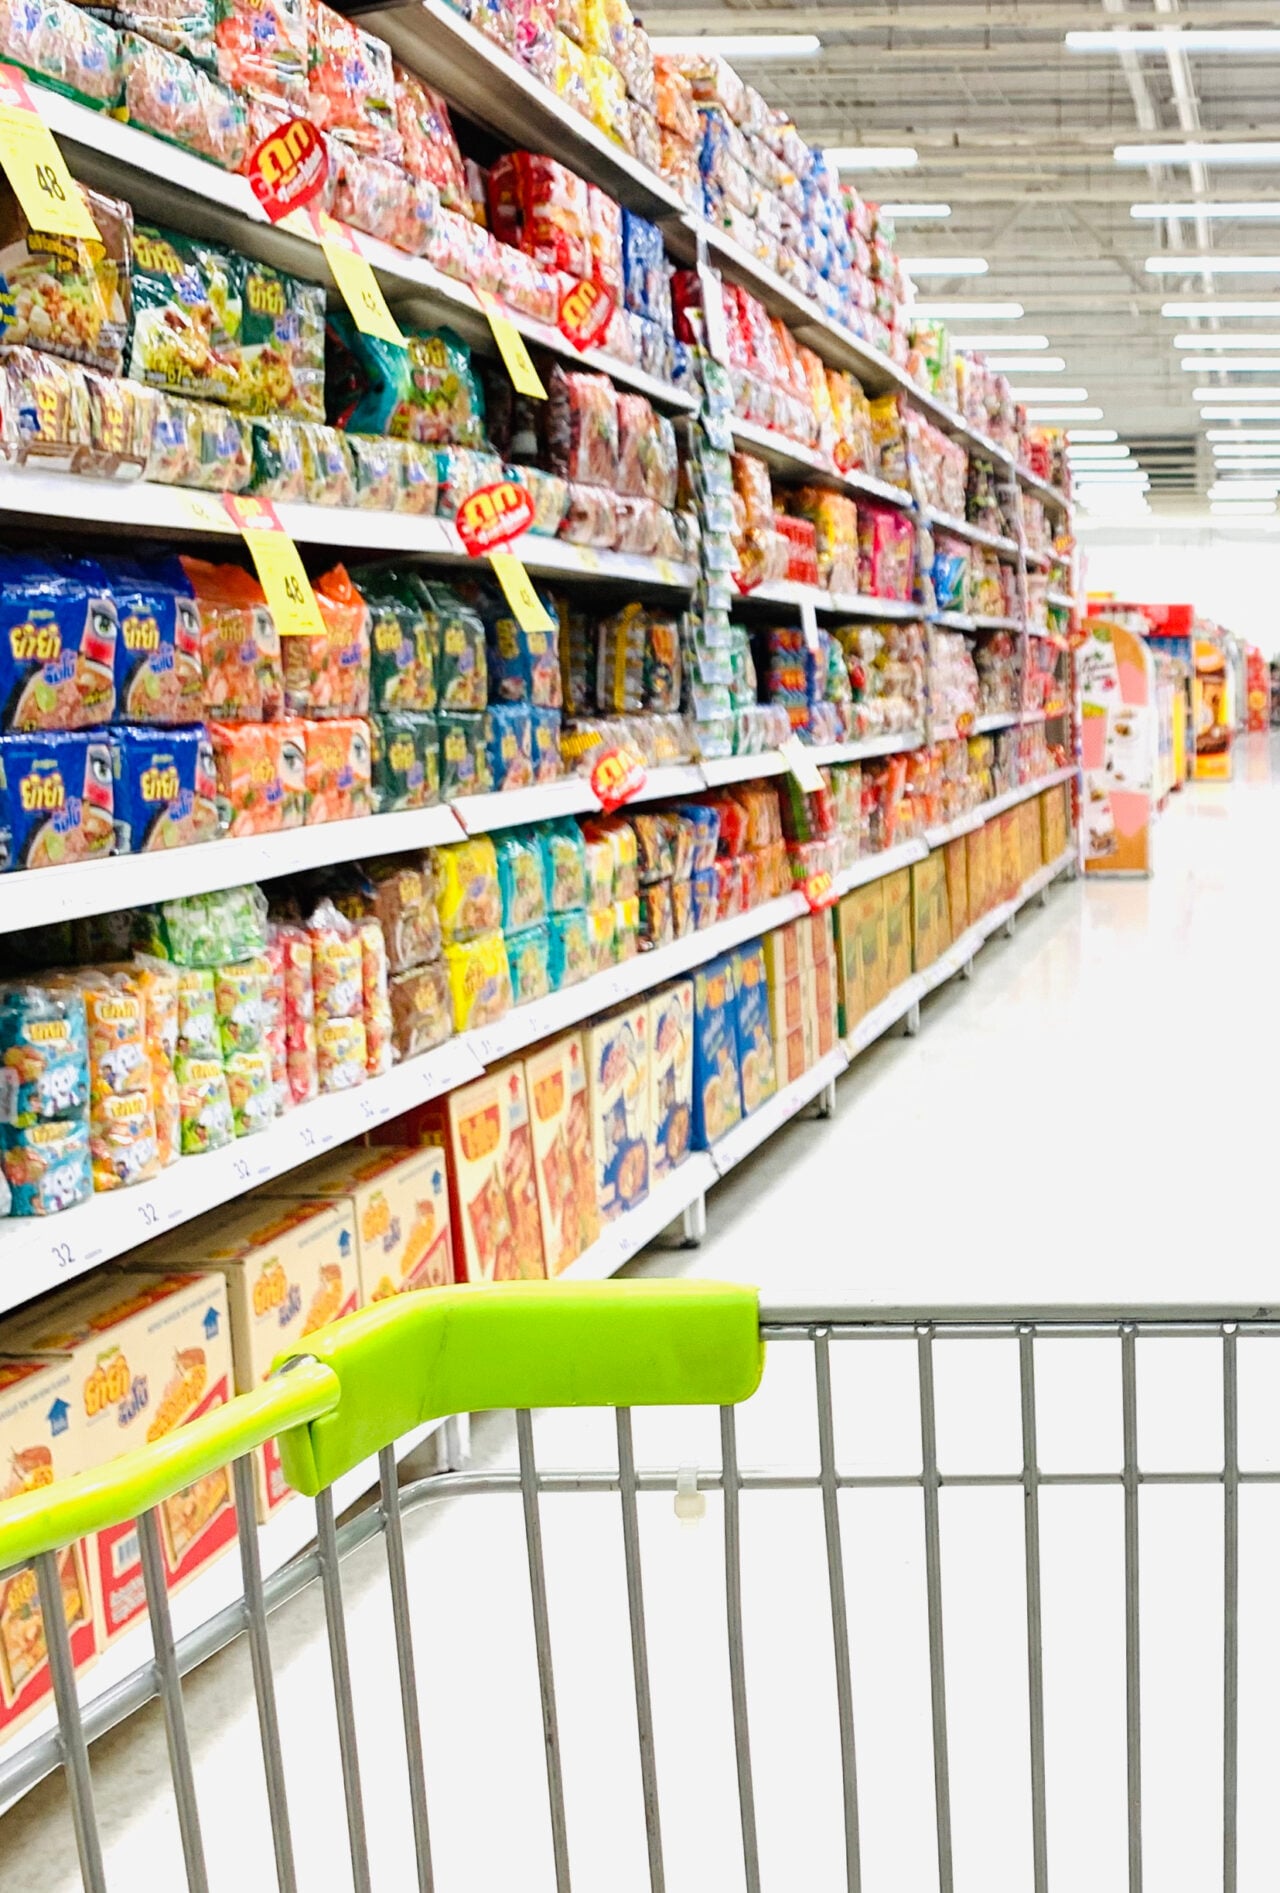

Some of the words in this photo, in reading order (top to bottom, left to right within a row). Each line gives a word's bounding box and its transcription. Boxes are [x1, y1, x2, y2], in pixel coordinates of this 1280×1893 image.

[35, 164, 66, 201] 48
[284, 575, 305, 605] 48
[138, 1203, 160, 1226] 32
[52, 1243, 76, 1268] 32
